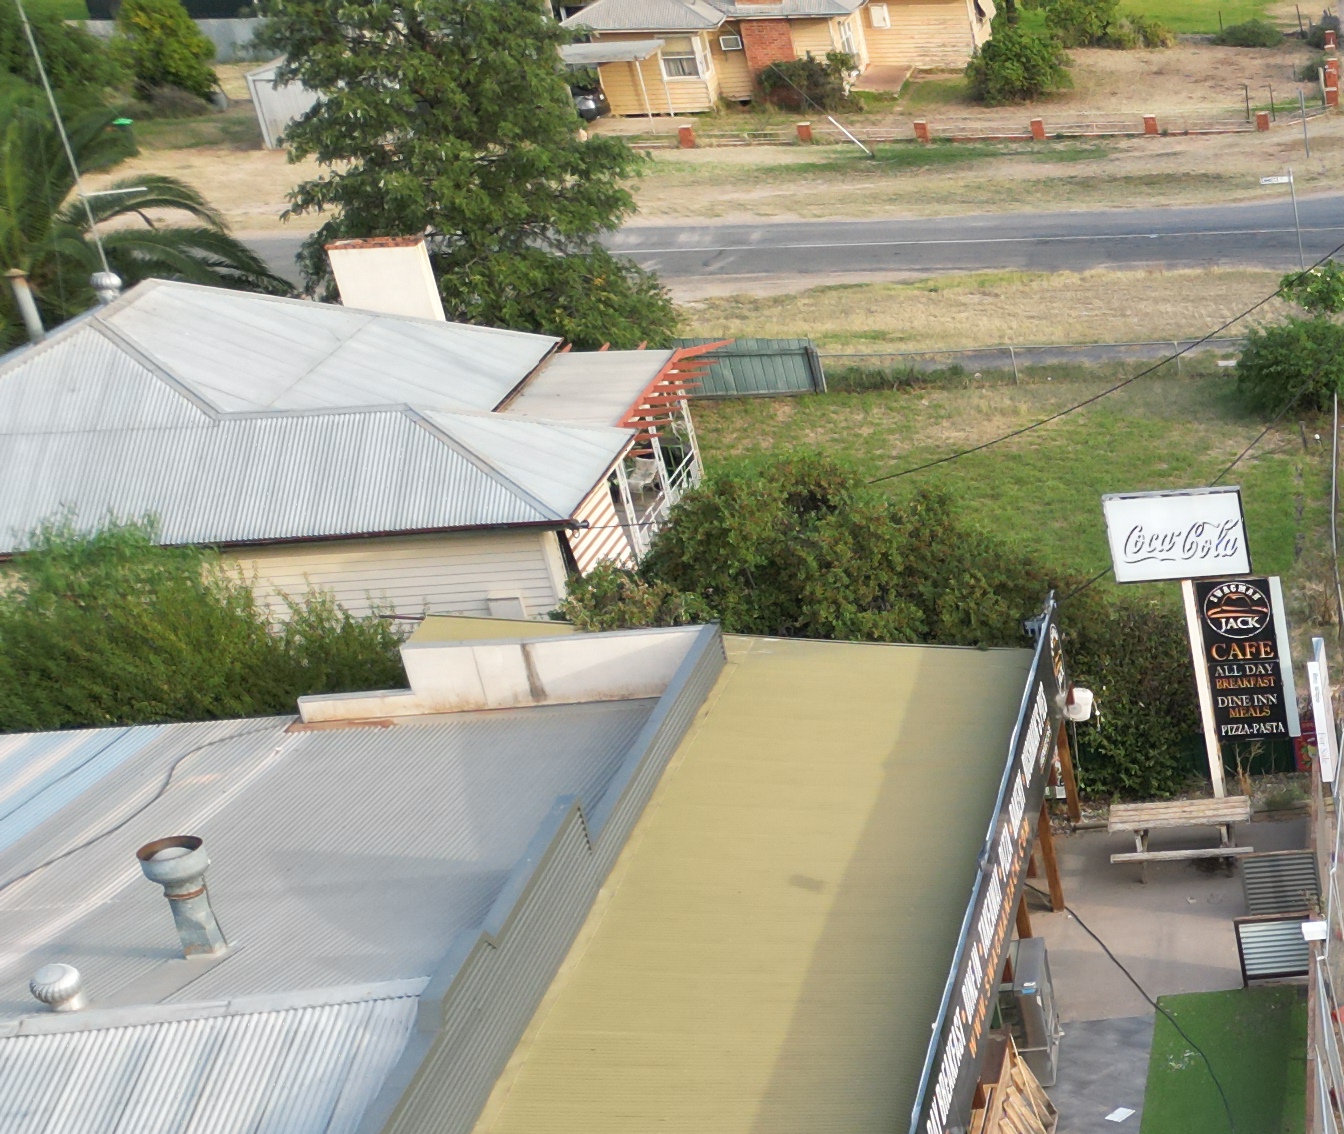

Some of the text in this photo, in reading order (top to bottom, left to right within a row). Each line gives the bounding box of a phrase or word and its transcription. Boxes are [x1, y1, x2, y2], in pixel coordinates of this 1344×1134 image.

[1209, 584, 1261, 602] SWAGMAN
[1219, 616, 1261, 632] JACK
[1210, 640, 1275, 661] CAFE
[1215, 663, 1275, 677] ALL DAY
[1215, 676, 1276, 690] BREAKFAST
[1217, 693, 1278, 708] DINE INN
[1229, 705, 1271, 718] MEALS
[935, 1006, 966, 1126] BREAKFAST
